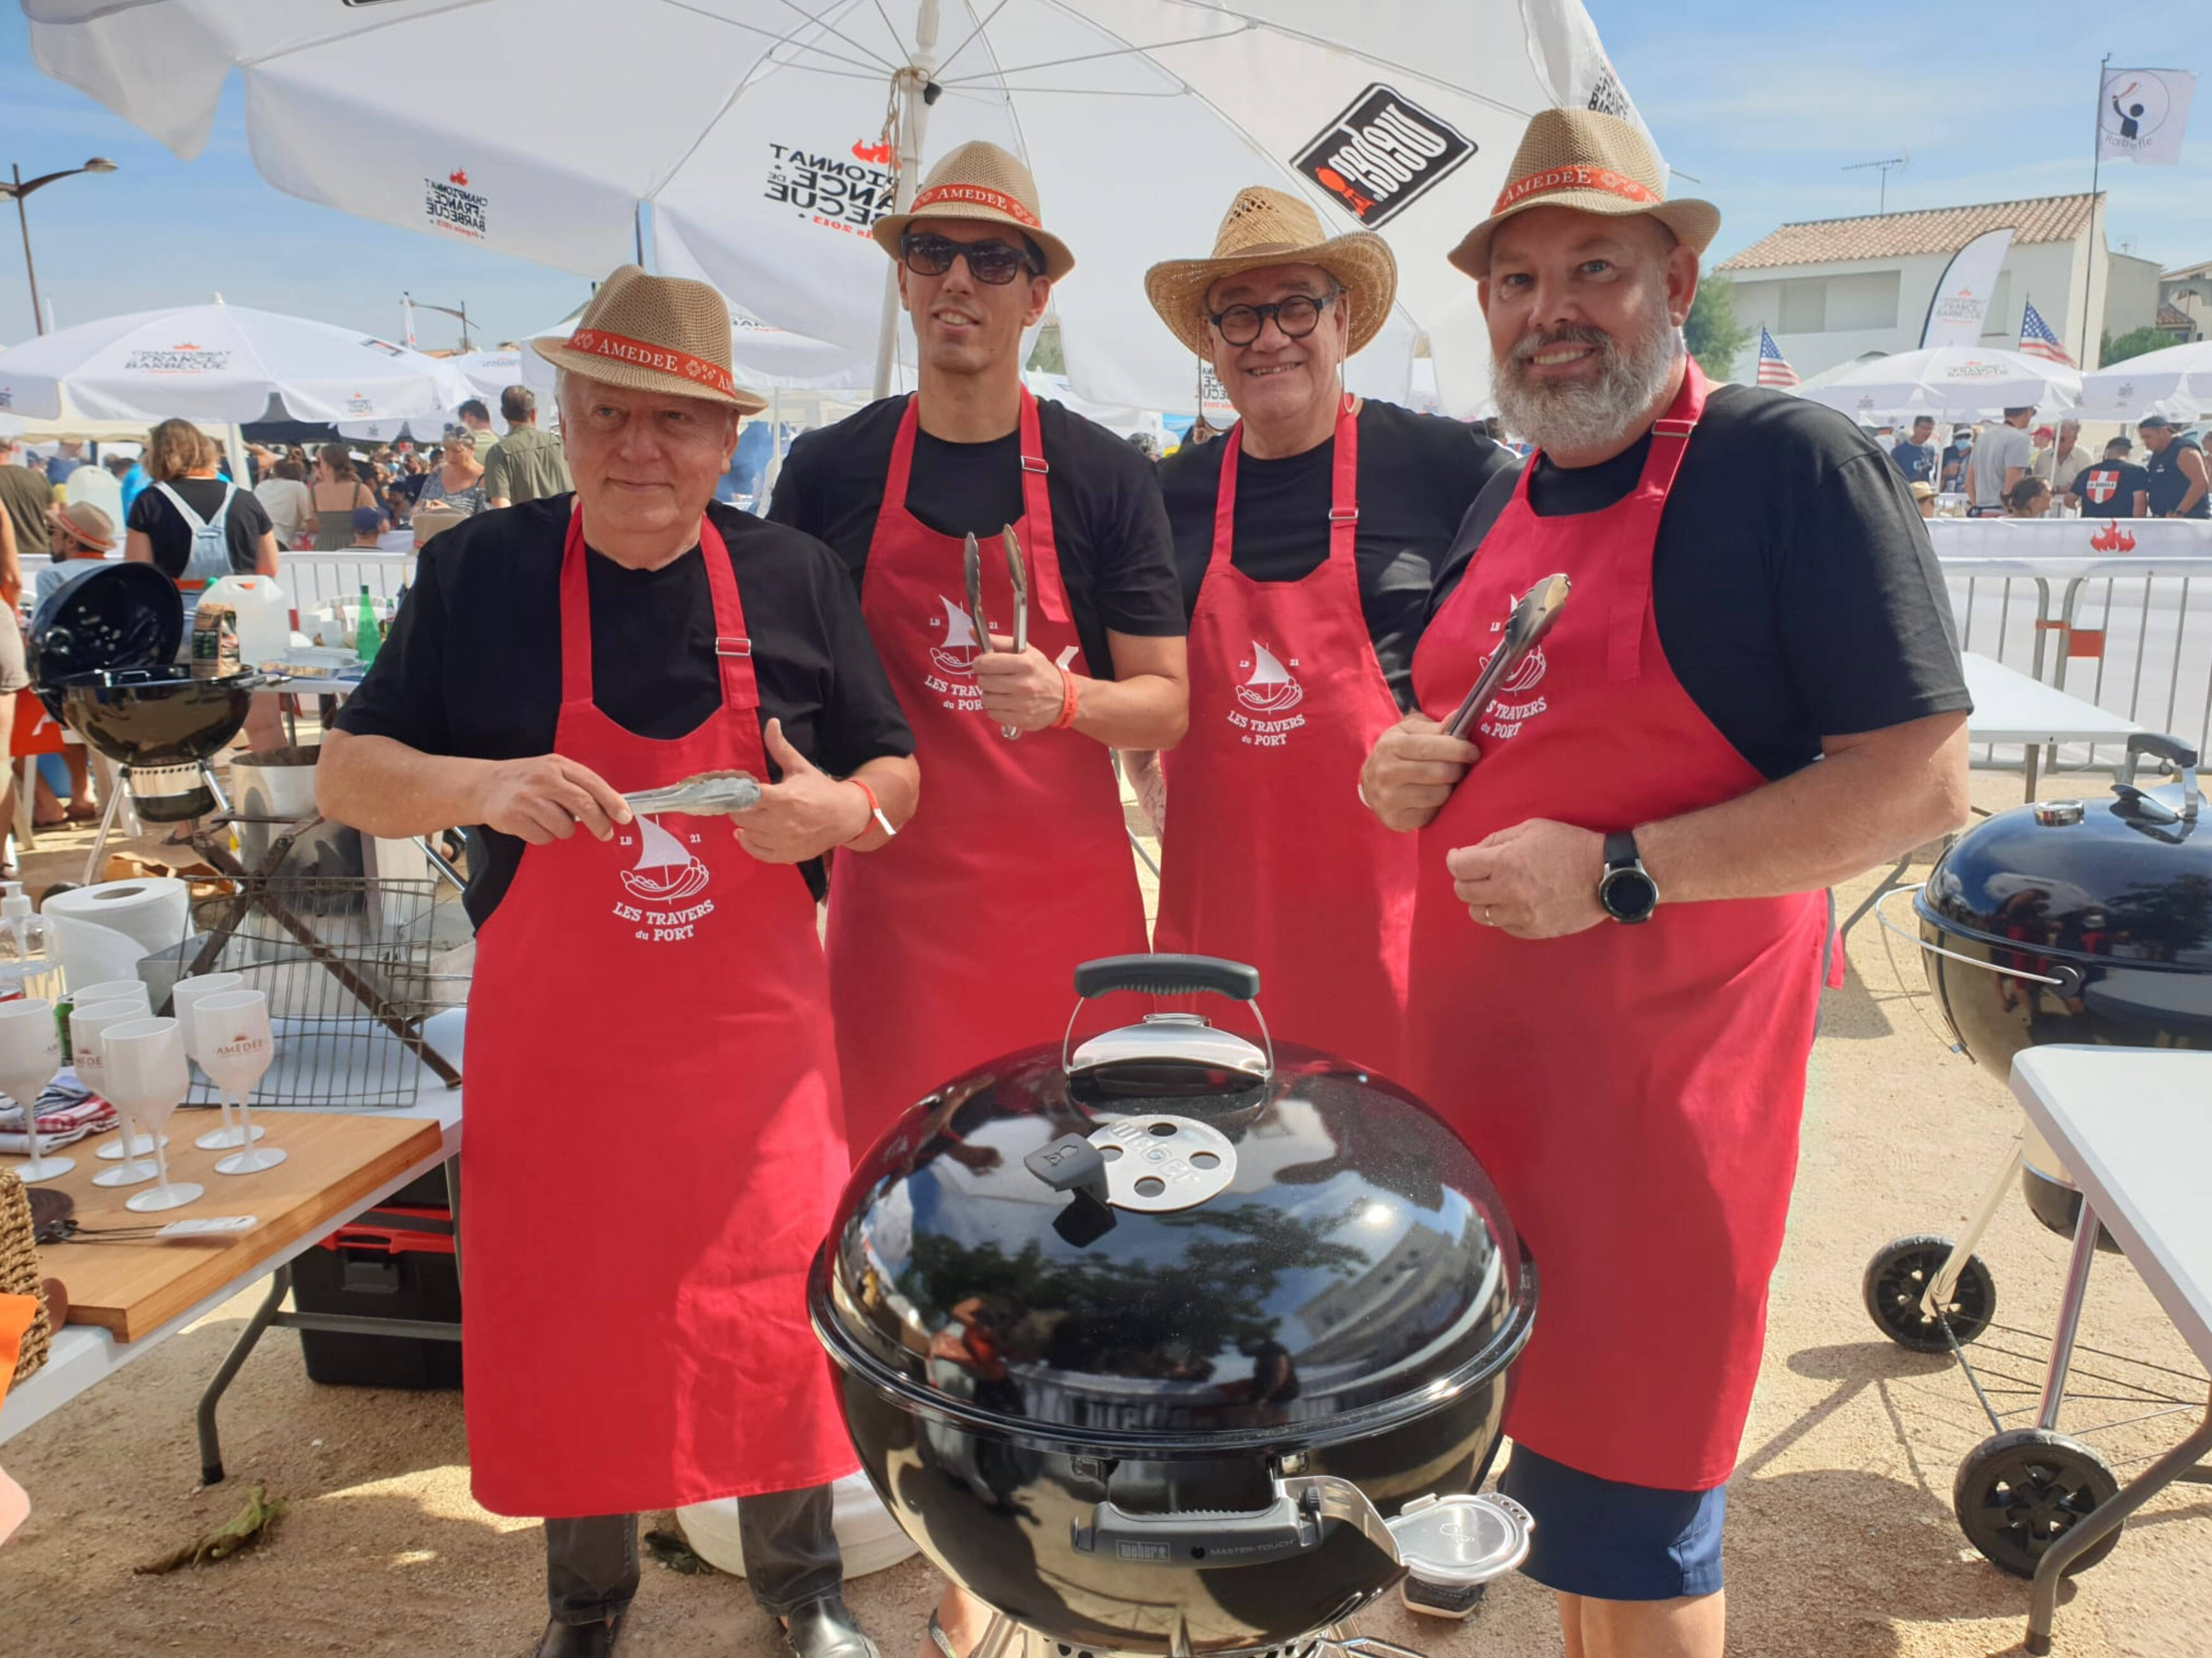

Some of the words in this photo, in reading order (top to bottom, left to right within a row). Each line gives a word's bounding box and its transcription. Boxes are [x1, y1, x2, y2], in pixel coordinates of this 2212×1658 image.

[924, 675, 948, 693] LES
[951, 684, 983, 697] TRAV
[943, 700, 954, 709] du
[958, 700, 983, 710] POR
[1494, 696, 1547, 721] TRAVERS
[1227, 710, 1249, 728] LES
[1250, 714, 1306, 732] TRAVERS
[1480, 722, 1491, 733] du
[1491, 722, 1522, 738] PORT
[1242, 735, 1252, 744] du
[1254, 733, 1287, 746] PORT
[690, 834, 701, 843] 21
[613, 902, 642, 921] LES
[646, 899, 715, 925] TRAVERS
[635, 930, 649, 939] du
[653, 925, 694, 941] PORT
